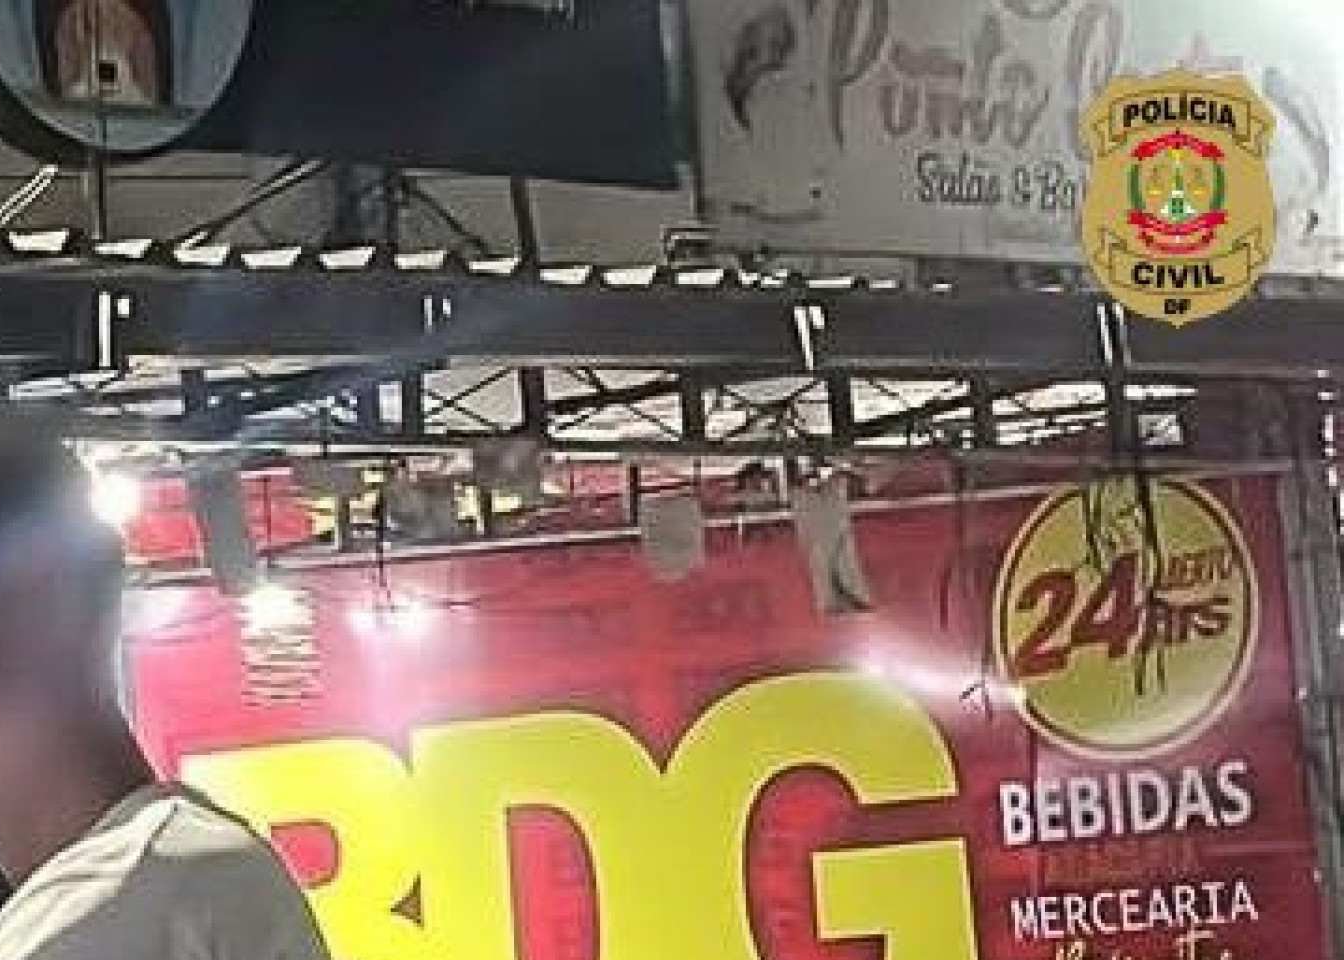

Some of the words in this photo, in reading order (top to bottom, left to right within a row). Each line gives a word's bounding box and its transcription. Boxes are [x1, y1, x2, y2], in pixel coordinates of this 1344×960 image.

[1014, 552, 1142, 680] 24
[998, 757, 1255, 847] BEBIDAS
[1010, 879, 1260, 941] MERCEARIA
